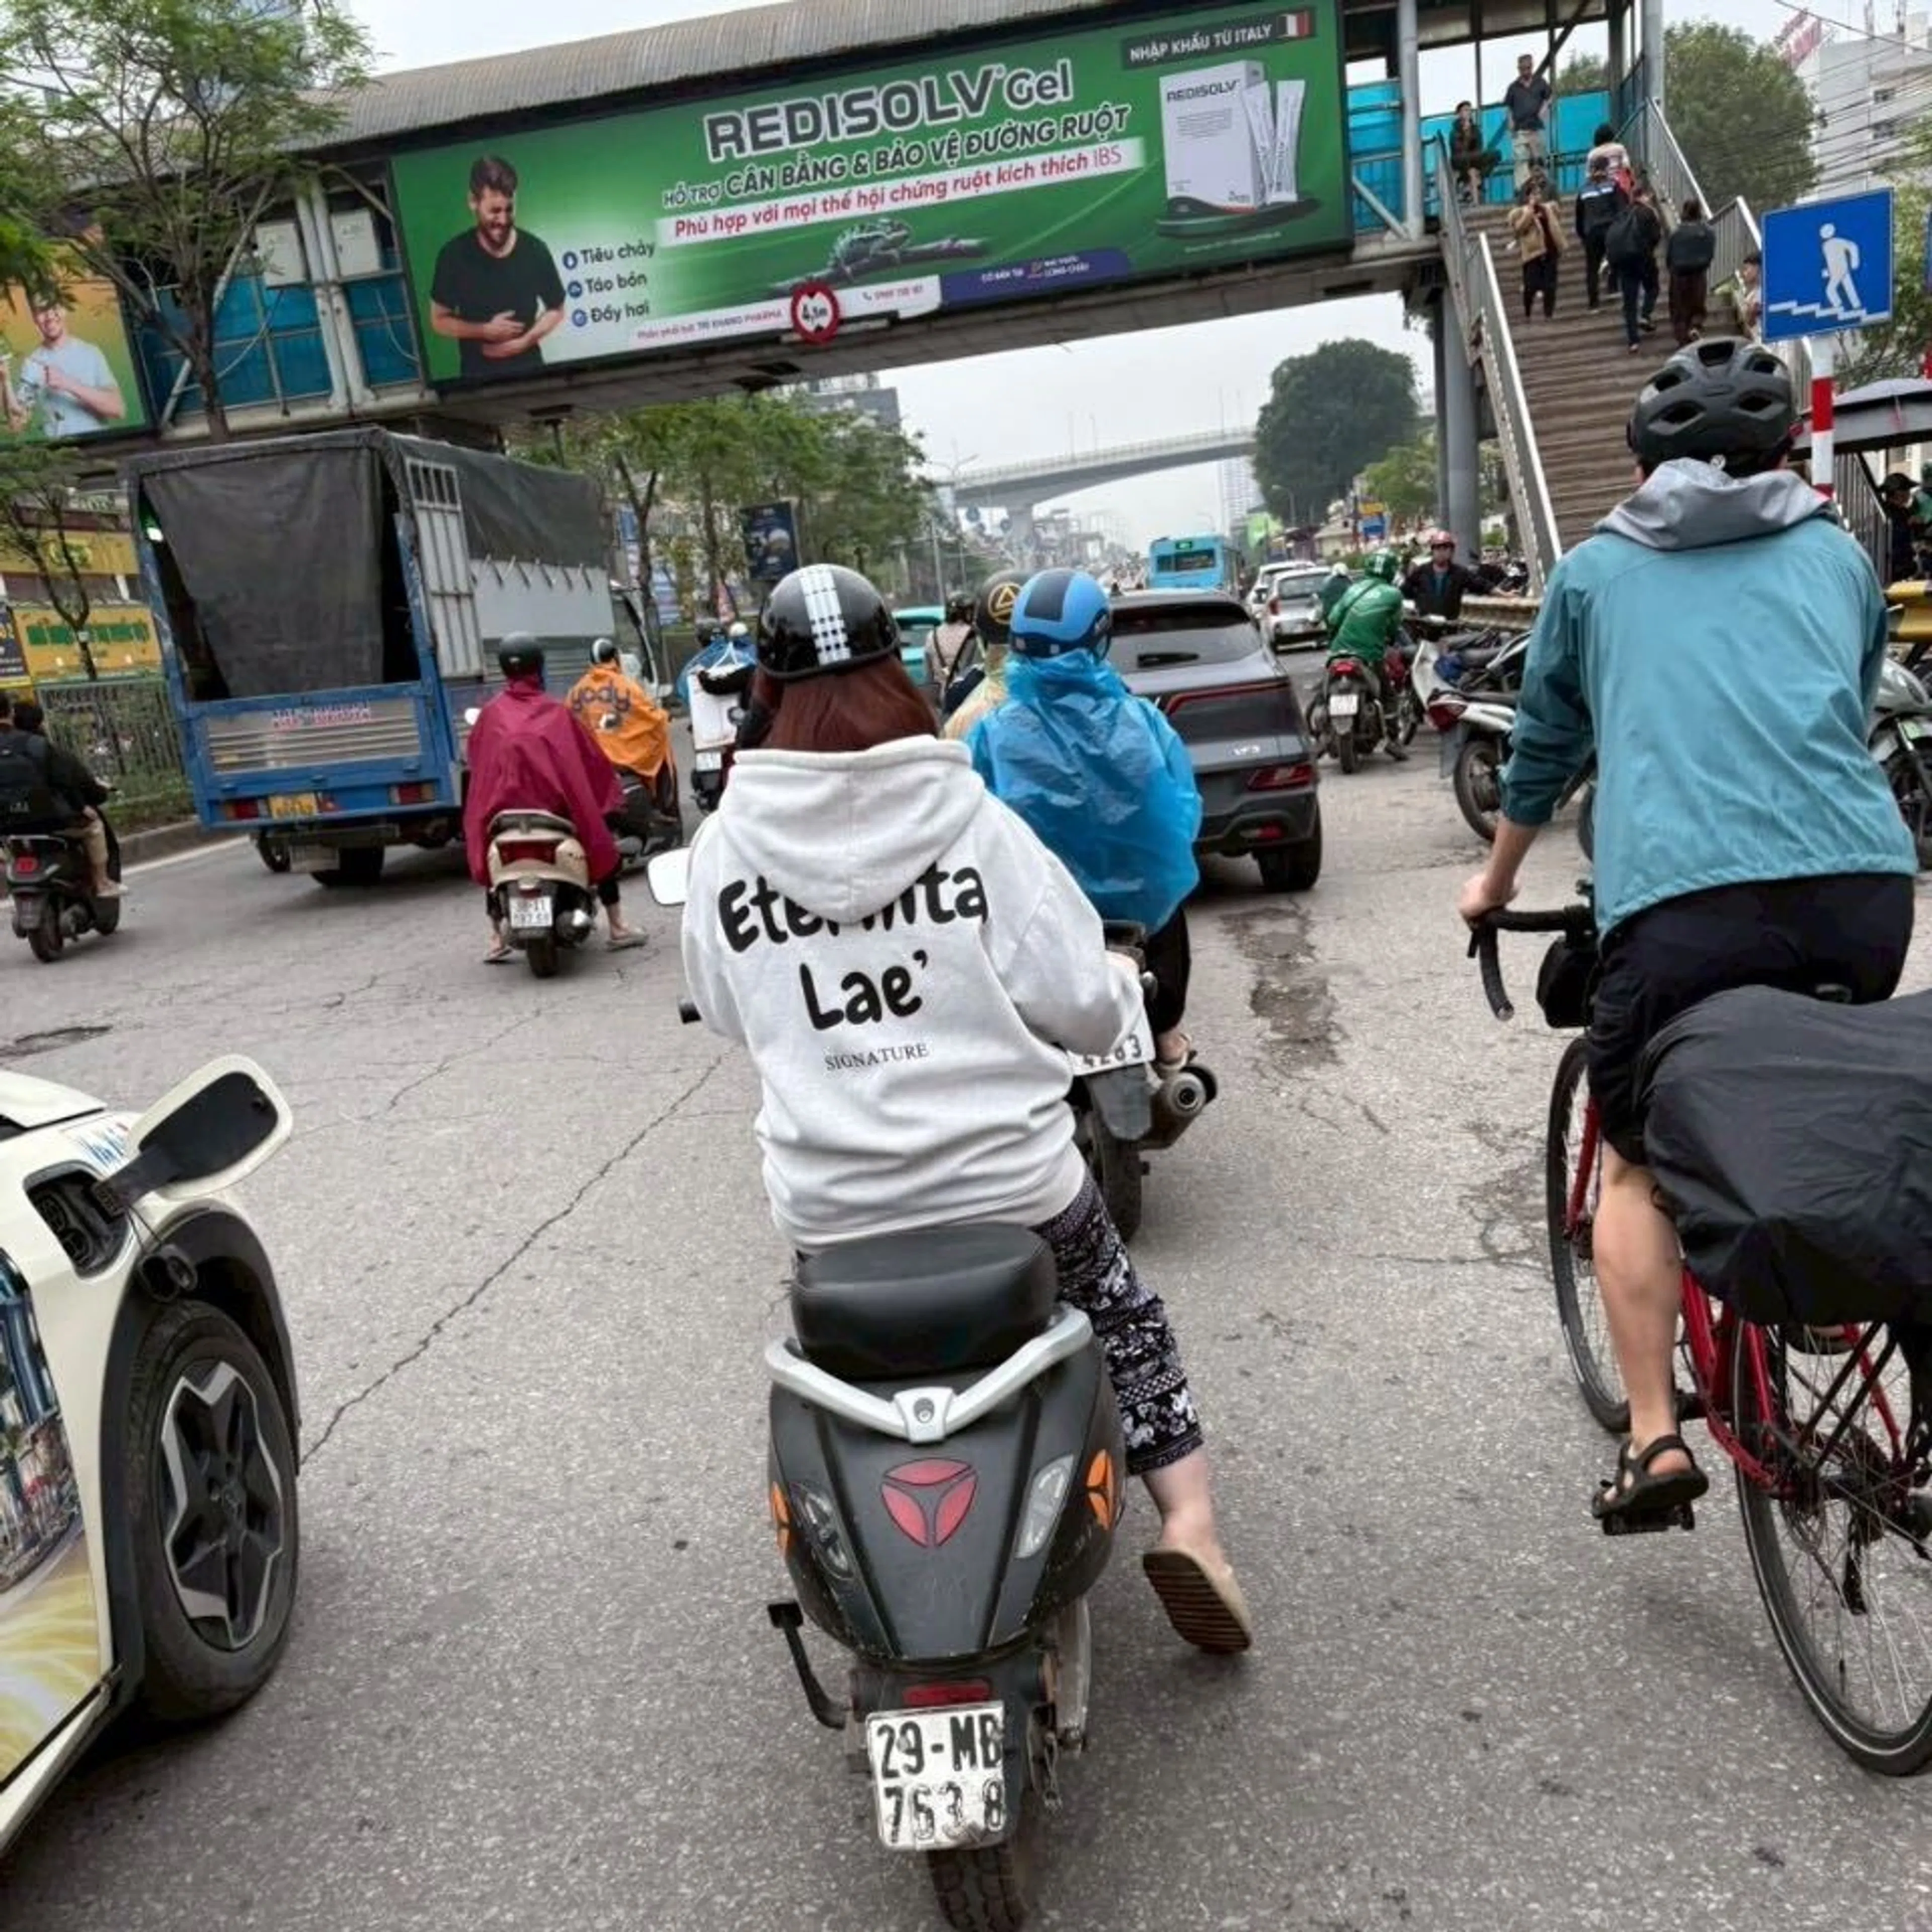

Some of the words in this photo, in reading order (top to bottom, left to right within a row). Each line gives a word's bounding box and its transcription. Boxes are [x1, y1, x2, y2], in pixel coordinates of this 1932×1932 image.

[1235, 24, 1272, 43] ITALY
[1006, 61, 1072, 107] Gel
[726, 166, 775, 195] CÂN
[782, 152, 846, 188] BẰNG
[852, 151, 869, 174] &
[875, 138, 924, 171] BẢO
[932, 131, 959, 166] VỆ
[965, 120, 1056, 156] ĐƯỜNG
[1062, 103, 1130, 141] RUỘT
[675, 215, 707, 237] Phù
[713, 211, 747, 232] hợp
[753, 203, 779, 224] với
[784, 197, 817, 221] mọi
[856, 187, 884, 209] hội
[890, 177, 947, 203] chứng
[953, 170, 991, 194] ruột
[997, 161, 1035, 184] kích
[1040, 152, 1089, 176] thích
[1093, 145, 1123, 169] IBS
[580, 247, 614, 264] Tiêu
[617, 238, 656, 259] chảy
[585, 276, 614, 294] Táo
[625, 299, 650, 318] hơi
[823, 1041, 931, 1073] SIGNATURE
